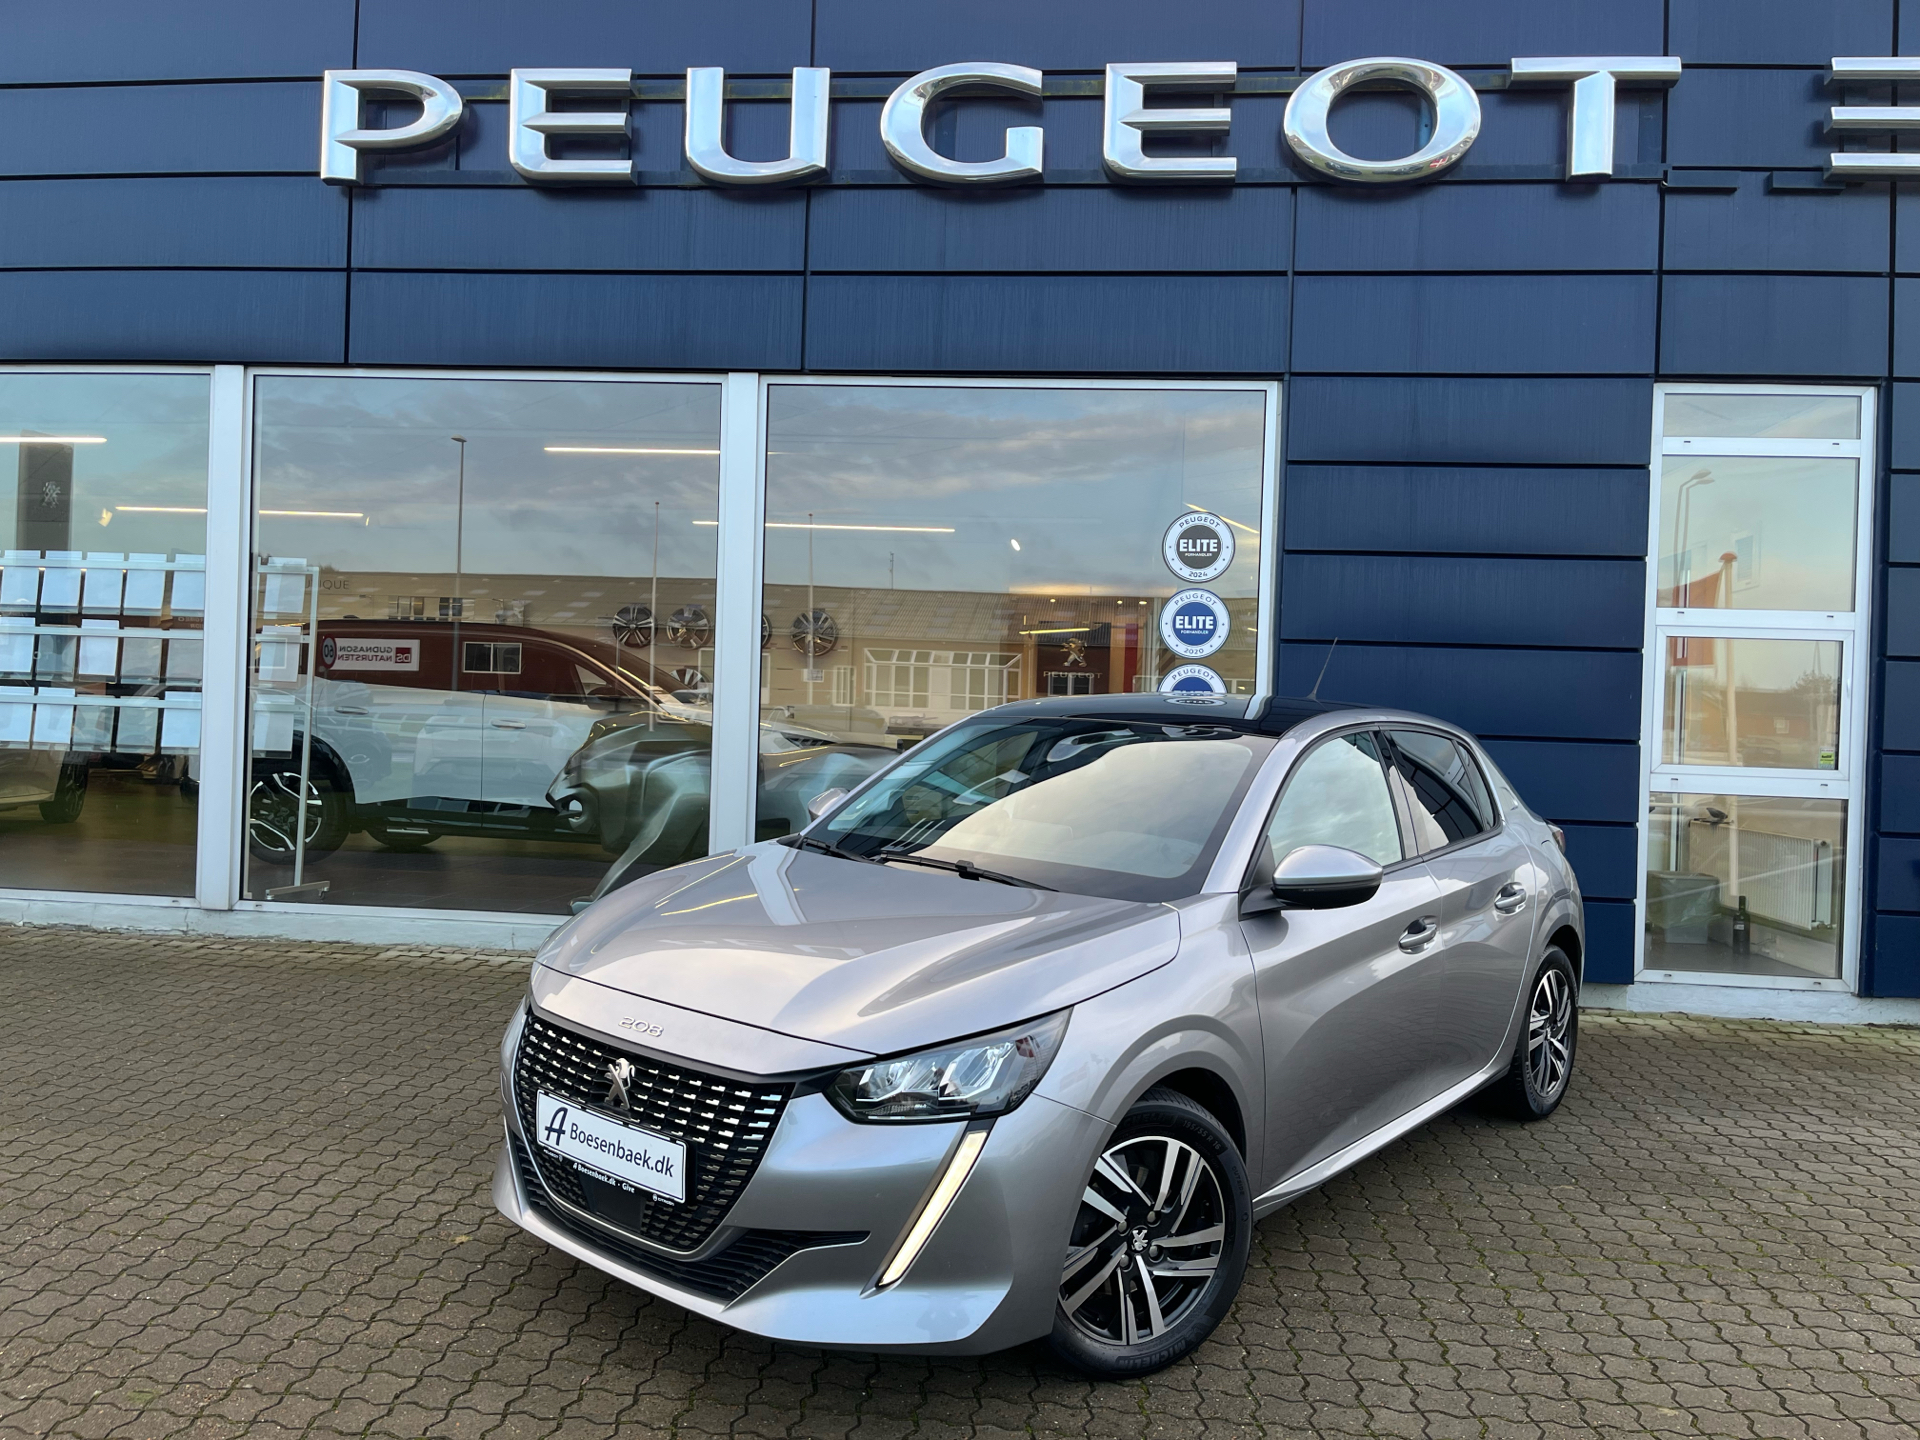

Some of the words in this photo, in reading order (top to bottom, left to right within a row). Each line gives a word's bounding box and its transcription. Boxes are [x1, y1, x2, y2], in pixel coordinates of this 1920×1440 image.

[320, 54, 1682, 188] PEUGEOT
[1178, 515, 1221, 530] PEUGEOT
[1179, 538, 1219, 552] ELITE
[1188, 570, 1208, 578] 2024
[1174, 592, 1218, 606] PEUGEOT
[1175, 616, 1214, 629] ELITE
[1184, 647, 1204, 655] 2020
[1043, 670, 1104, 680] PEUGEOT
[1171, 668, 1216, 681] PEUGEOT
[617, 1015, 664, 1038] 208
[1182, 1119, 1207, 1137] 195/55
[1206, 1135, 1213, 1143] R
[1212, 1140, 1222, 1150] 16
[570, 1122, 676, 1178] Boesenbaek.dk
[578, 1164, 617, 1187] Boesenbaek.dk
[621, 1182, 635, 1194] Give
[1231, 1165, 1245, 1196] OUTSIDE
[1117, 1339, 1186, 1370] MICHELIN
